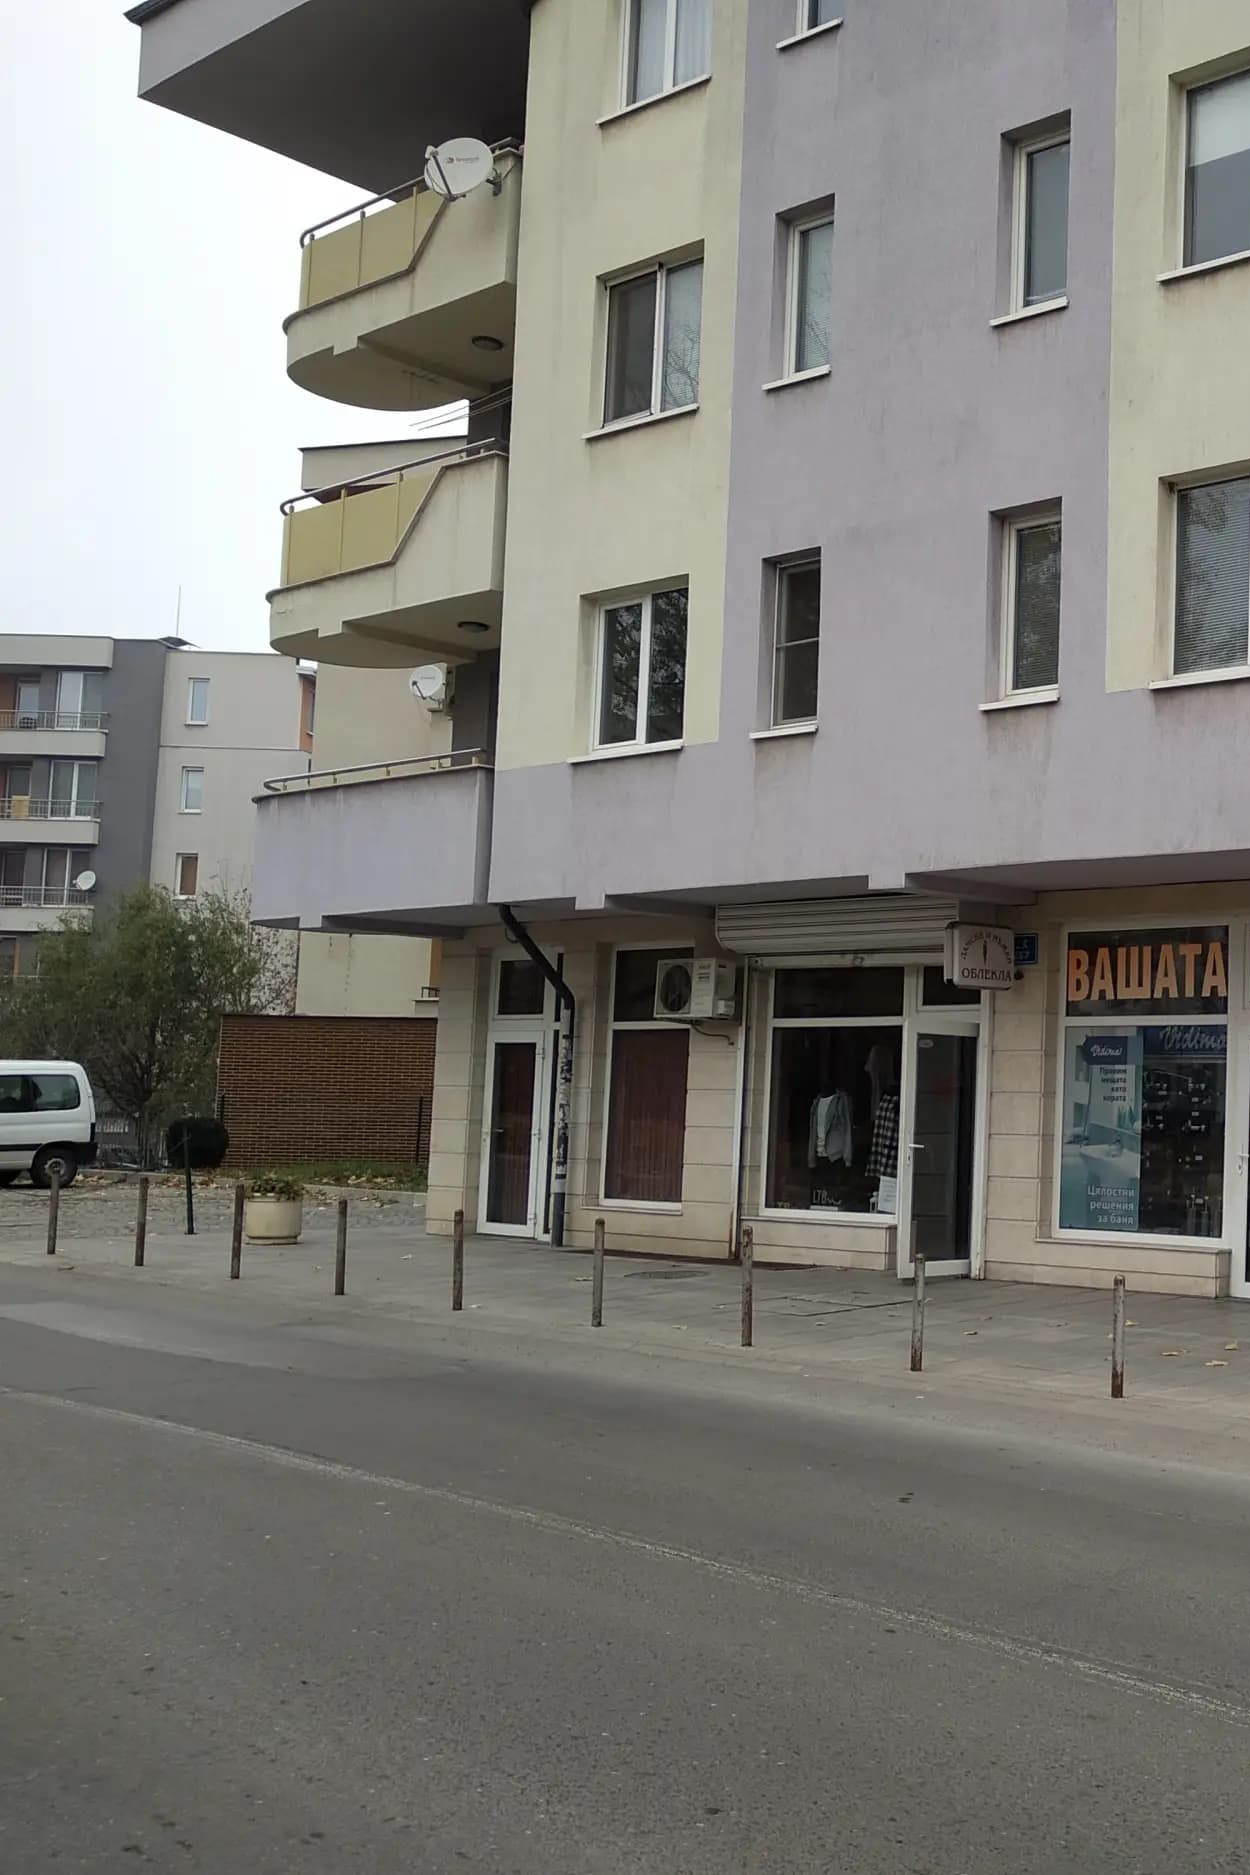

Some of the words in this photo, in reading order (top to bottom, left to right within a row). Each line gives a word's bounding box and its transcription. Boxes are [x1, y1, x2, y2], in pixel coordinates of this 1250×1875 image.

[961, 967, 1012, 982] ОБЛЕКЛА
[1068, 941, 1228, 1001] ВАШАТА
[1087, 1184, 1135, 1197] Цялостни
[1090, 1200, 1134, 1212] решения
[1097, 1214, 1108, 1223] за
[1110, 1212, 1134, 1225] баня
